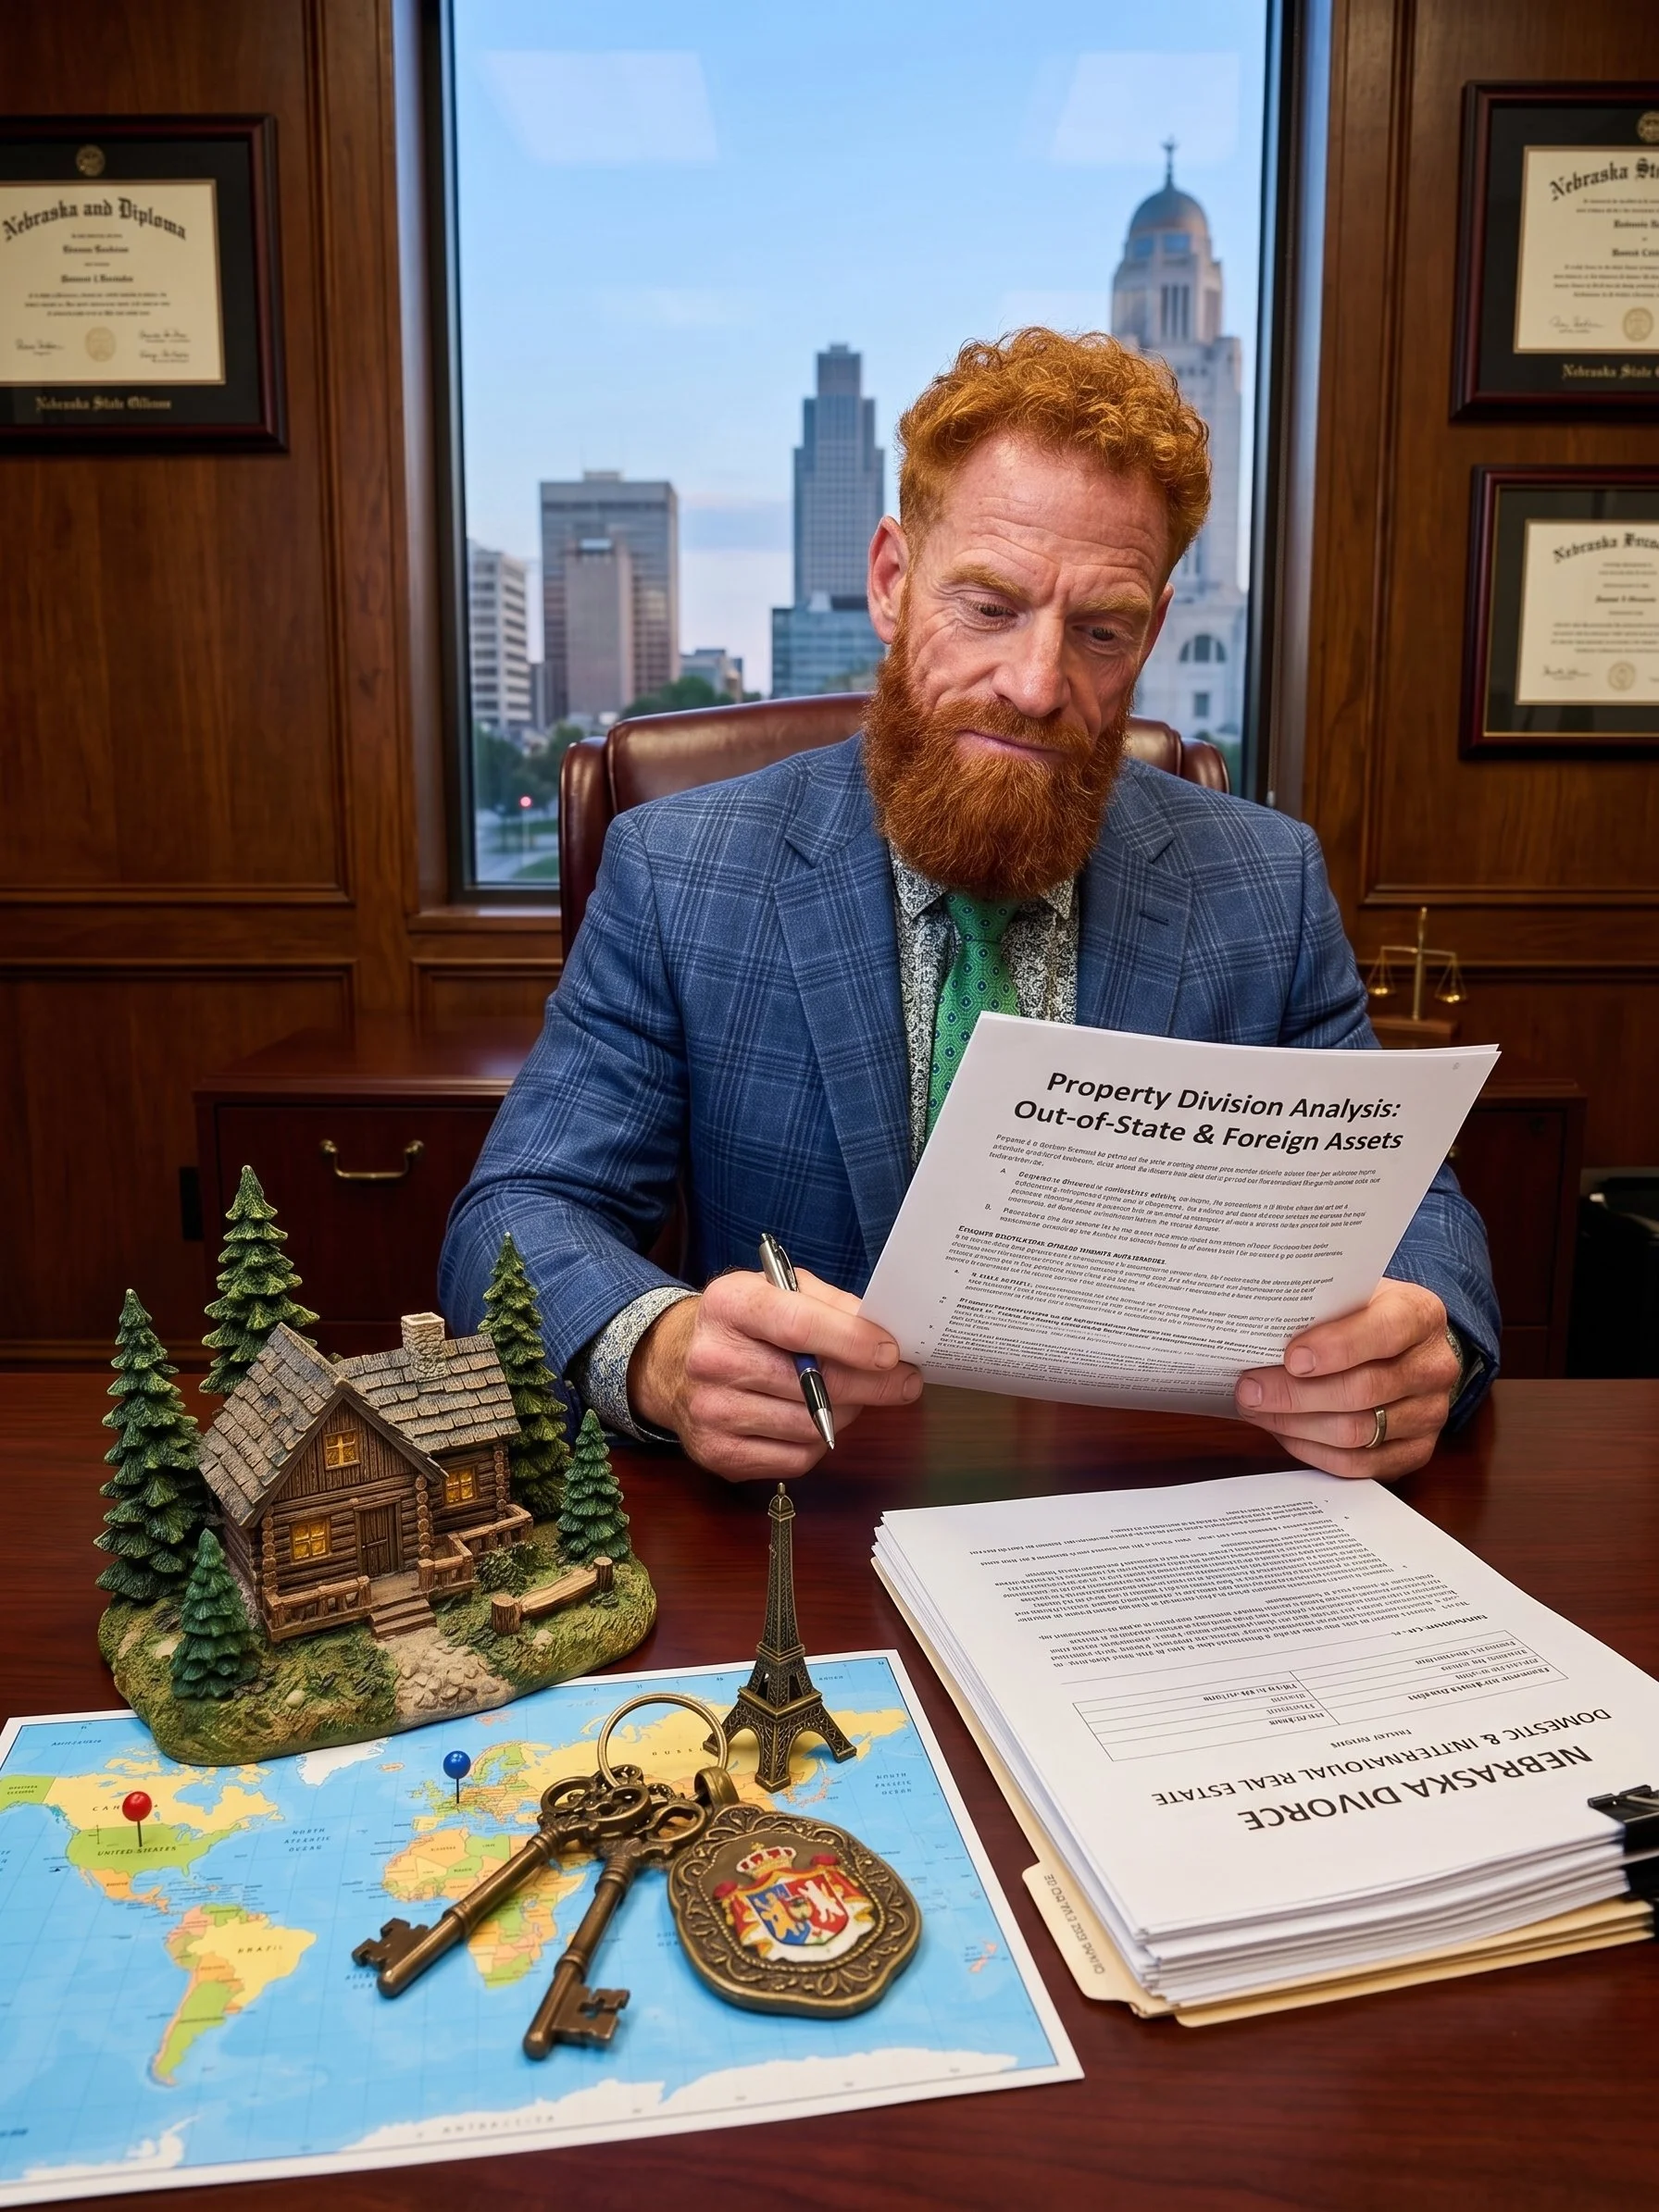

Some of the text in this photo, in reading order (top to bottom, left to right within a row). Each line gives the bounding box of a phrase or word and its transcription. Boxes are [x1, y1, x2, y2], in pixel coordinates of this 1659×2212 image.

[1550, 160, 1628, 203] Nebraska
[2, 196, 187, 242] Nebraska and Diploma
[1047, 1072, 1402, 1124] Property Division Analysis:
[1014, 1100, 1403, 1154] Out-of-State & Foreign Assets
[1479, 1734, 1501, 1746] &
[1502, 1709, 1613, 1741] DOMESTIC
[1151, 1782, 1237, 1806] ESTATE
[1237, 1746, 1593, 1831] NEBRASKA DIVORCE
[1238, 1771, 1297, 1791] REAL
